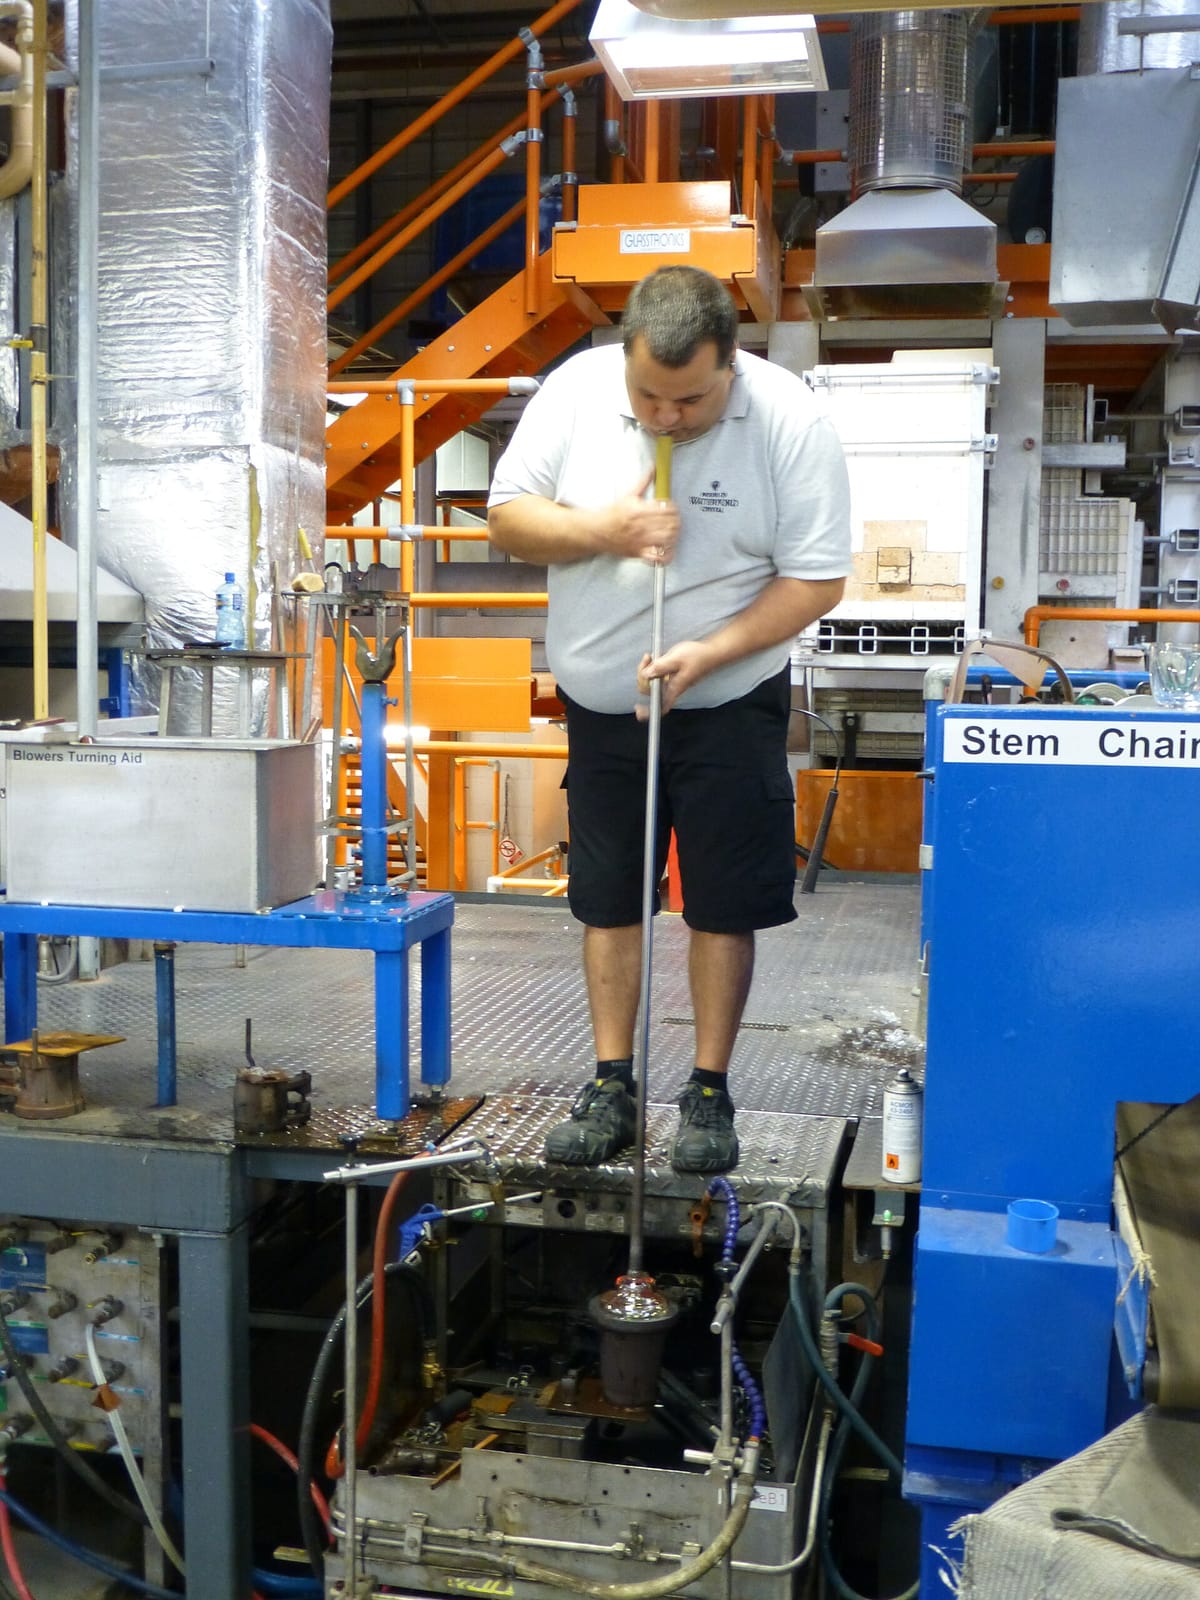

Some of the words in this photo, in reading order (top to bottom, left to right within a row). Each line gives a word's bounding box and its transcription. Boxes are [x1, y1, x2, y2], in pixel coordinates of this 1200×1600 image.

[962, 725, 1059, 756] Stem
[1098, 728, 1200, 760] Chair
[13, 749, 64, 762] Blowers
[68, 751, 117, 766] Turning
[121, 752, 142, 764] Aid
